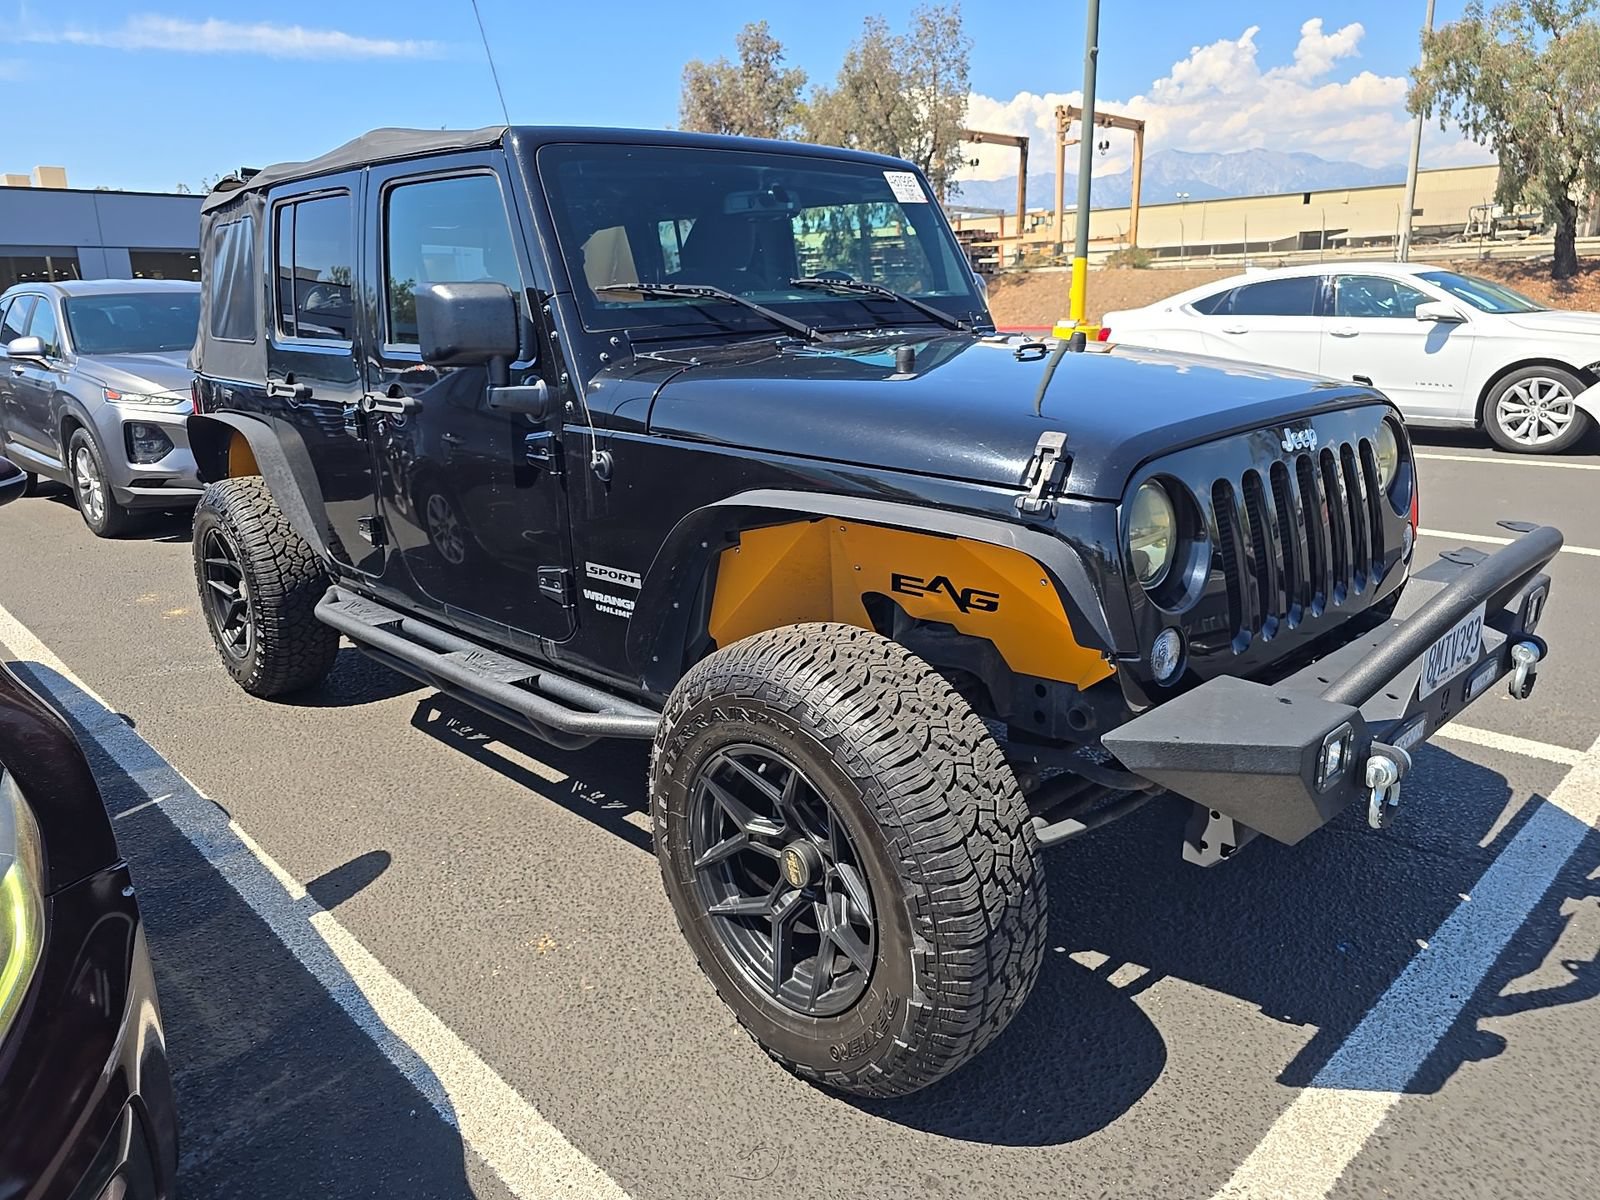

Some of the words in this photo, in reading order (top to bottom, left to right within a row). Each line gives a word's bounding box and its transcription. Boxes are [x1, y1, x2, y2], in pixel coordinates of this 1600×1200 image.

[1281, 427, 1318, 452] Jeep
[586, 565, 641, 584] SPORT
[1426, 615, 1482, 684] 8MIV393
